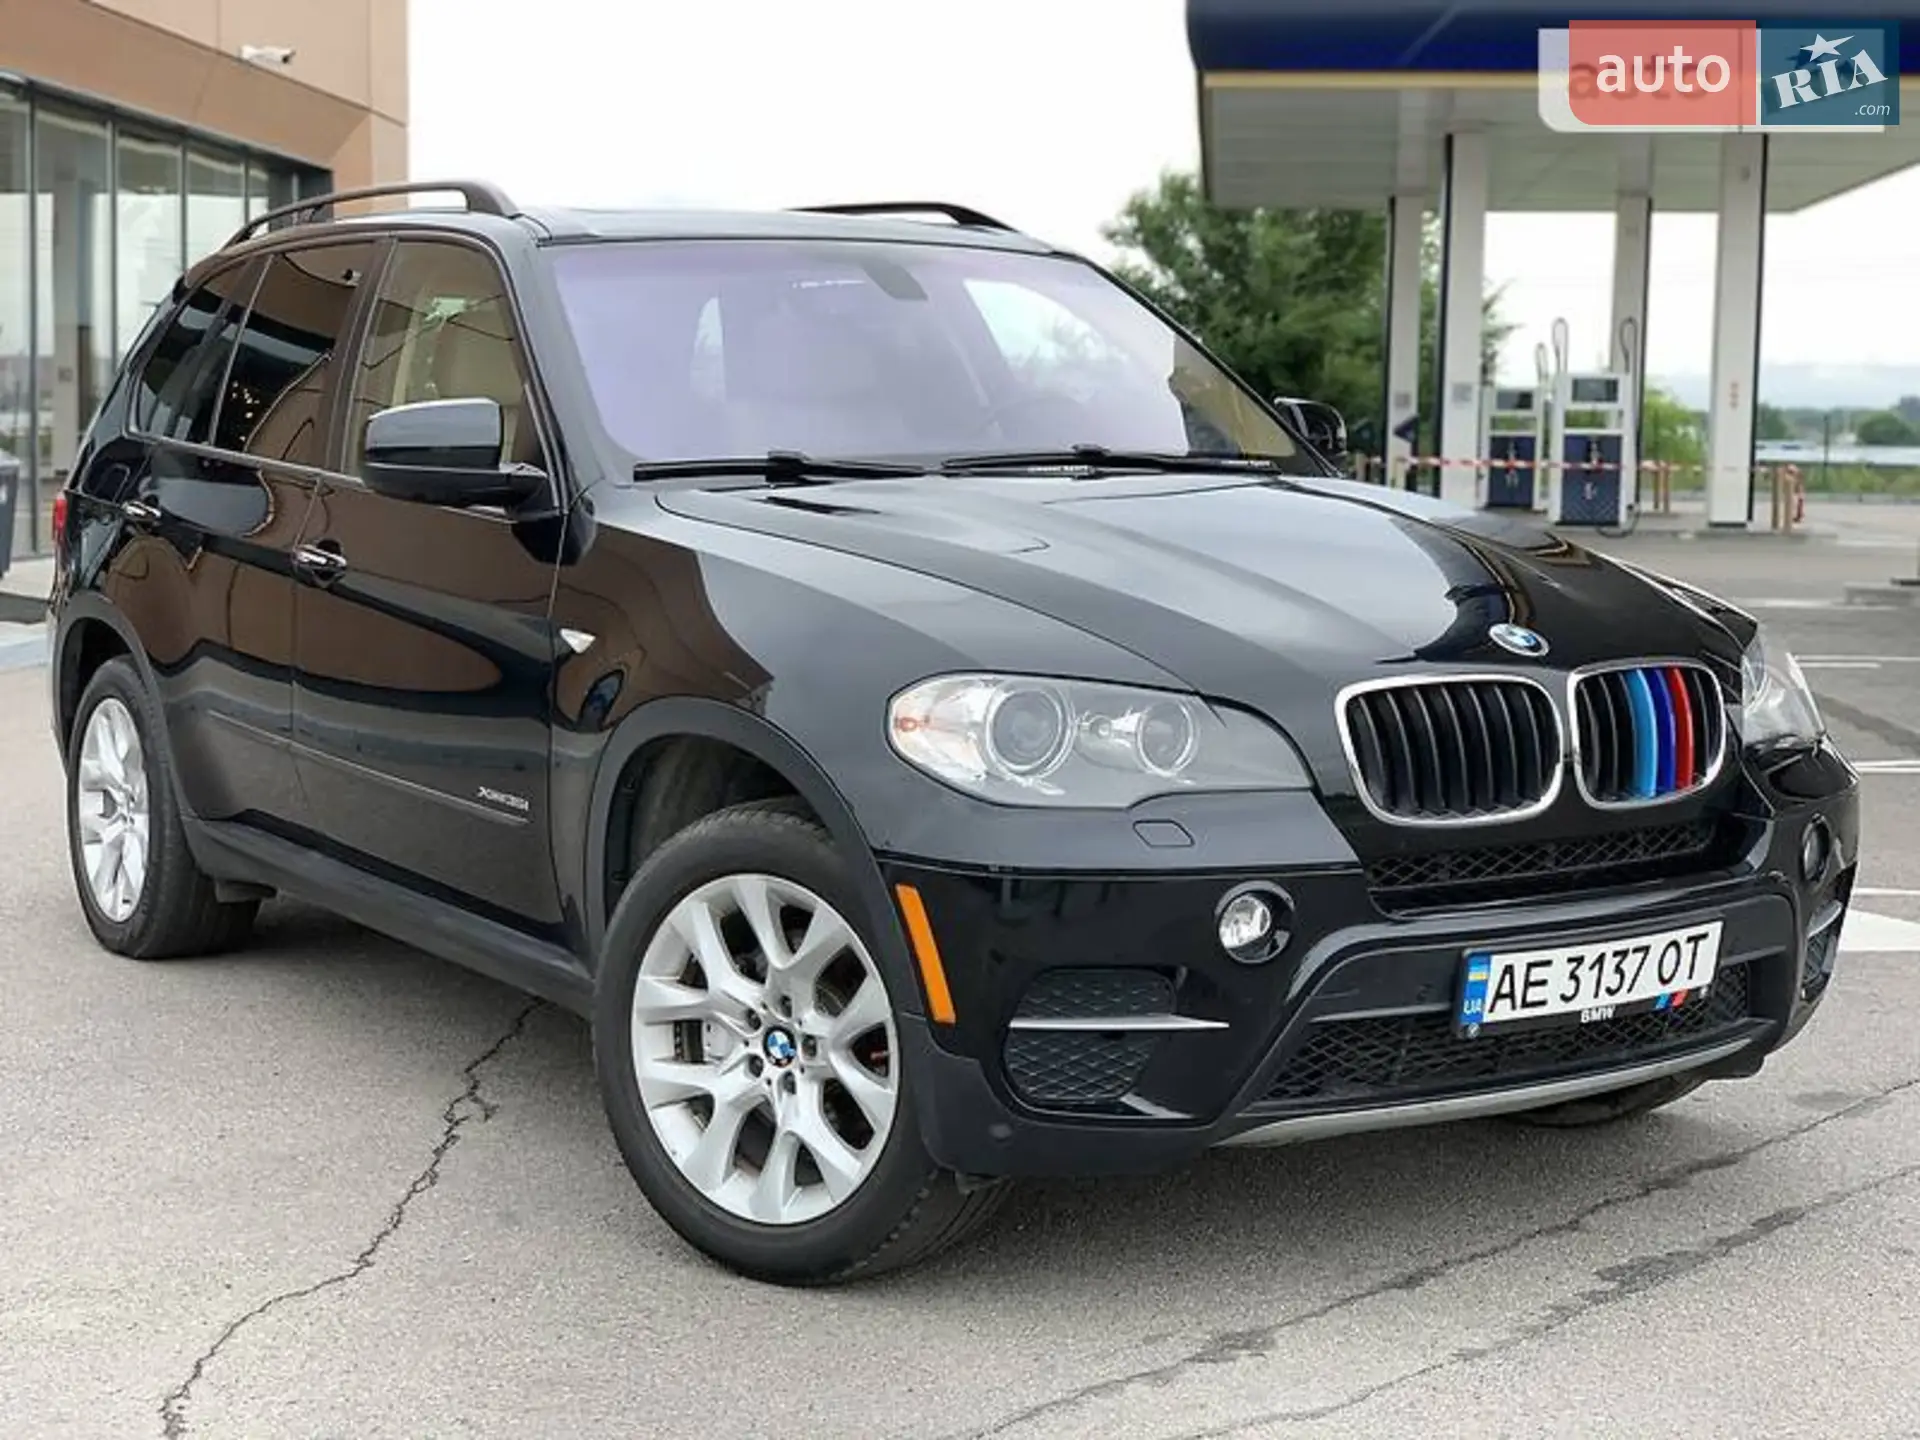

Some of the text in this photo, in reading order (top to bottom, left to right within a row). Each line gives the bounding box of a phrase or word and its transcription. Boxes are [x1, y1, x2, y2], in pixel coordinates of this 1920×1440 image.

[1488, 932, 1709, 1013] AE 3137 OT
[1580, 1005, 1616, 1023] BMW
